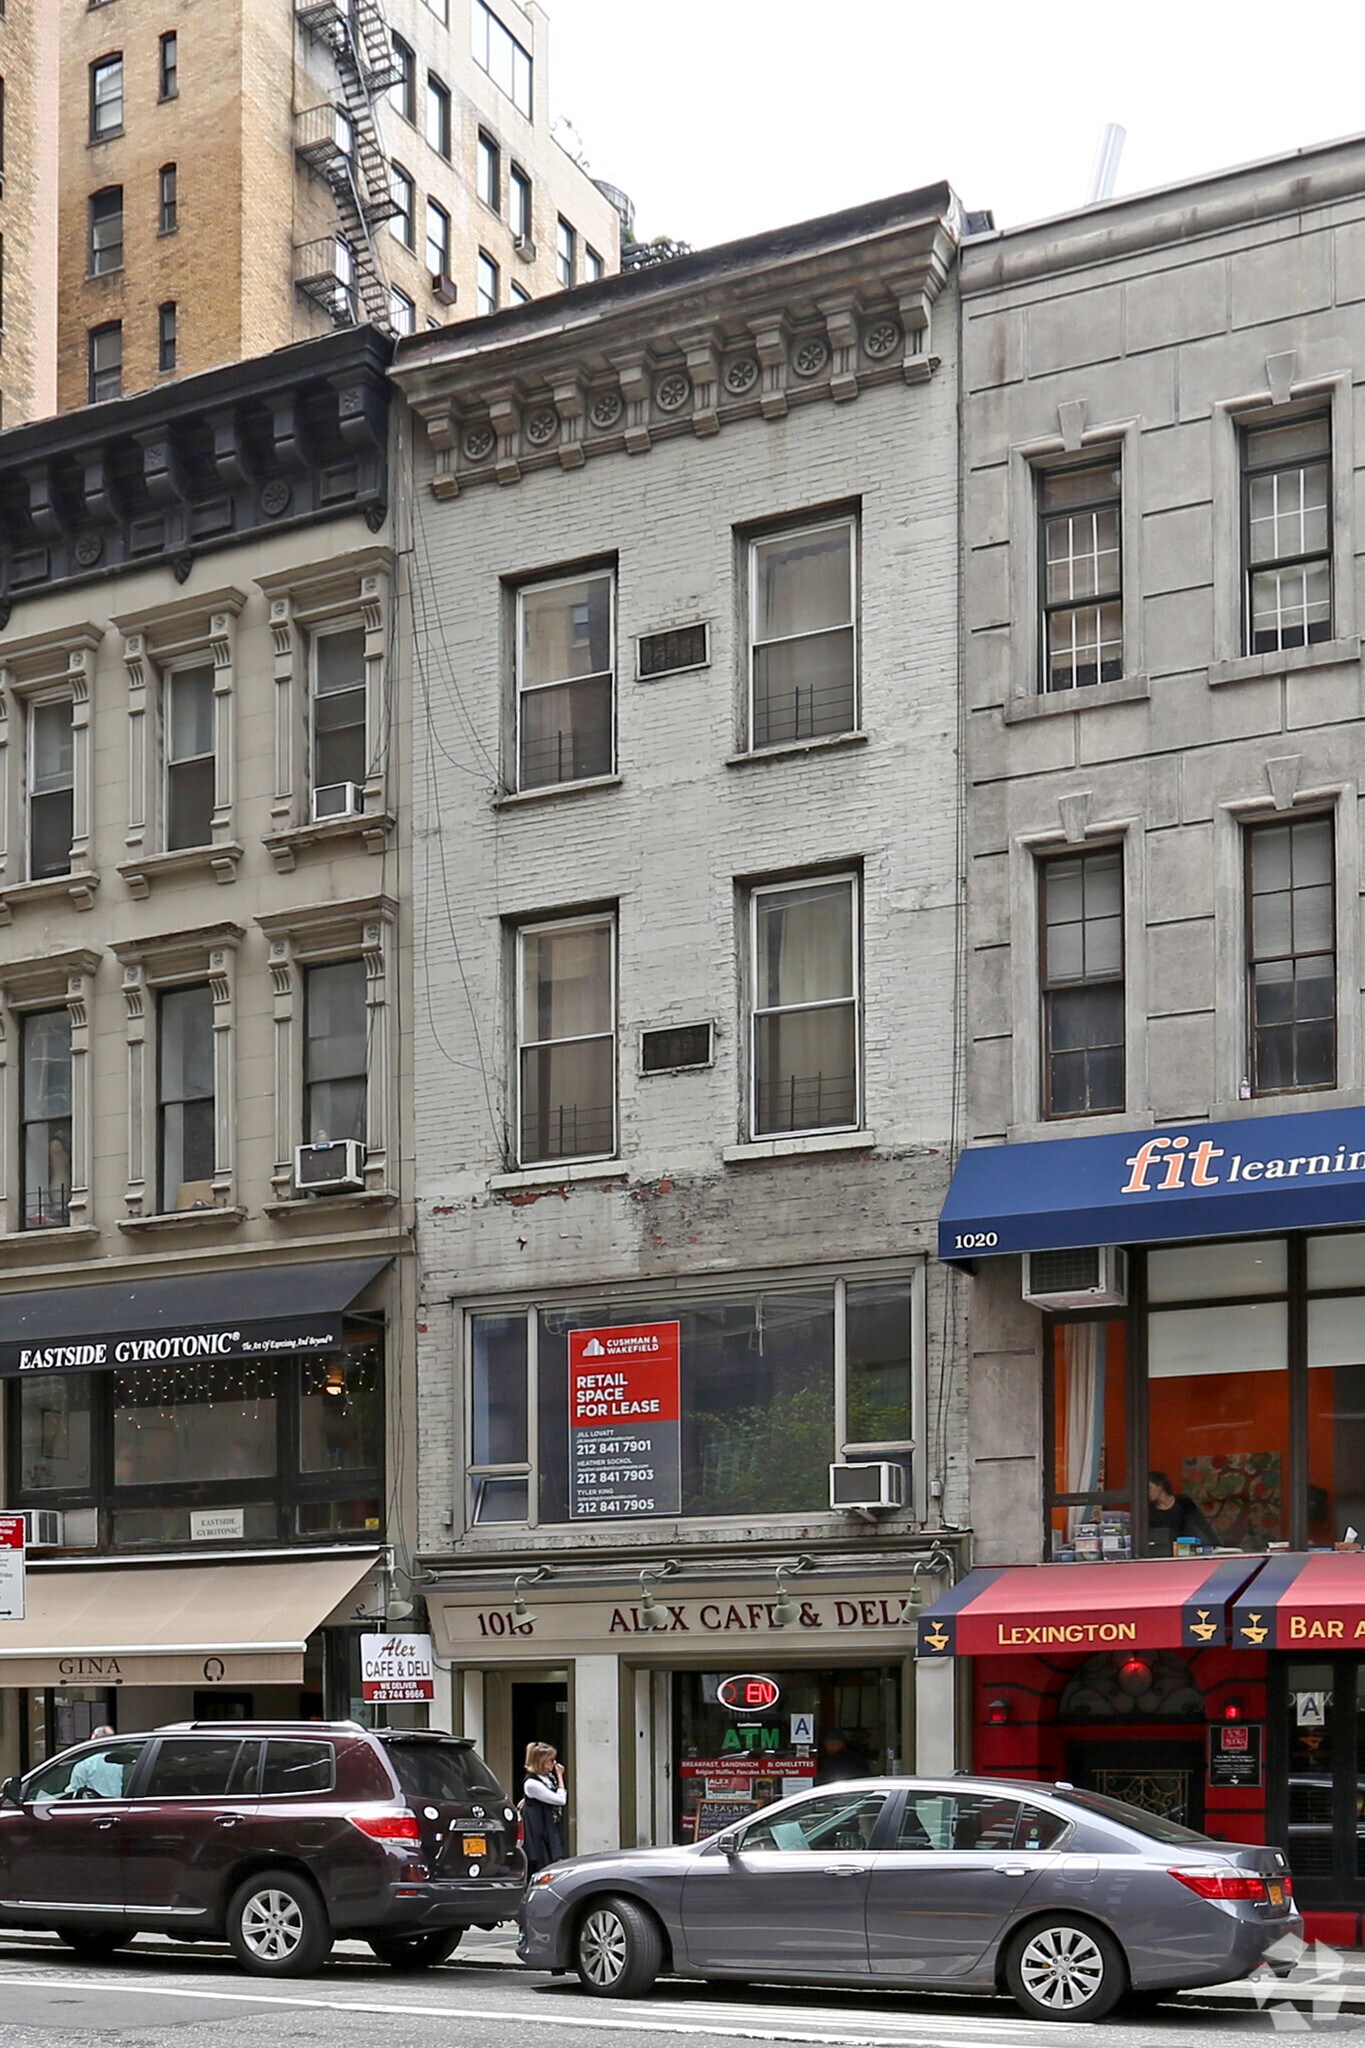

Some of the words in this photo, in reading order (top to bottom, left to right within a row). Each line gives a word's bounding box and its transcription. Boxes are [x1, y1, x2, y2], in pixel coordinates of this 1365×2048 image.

[1121, 1136, 1225, 1193] fit
[955, 1232, 998, 1249] 1020
[606, 1336, 651, 1347] CUSHMAN
[607, 1344, 659, 1355] WAKEFIELD
[19, 1344, 107, 1370] EASTSIDE
[577, 1373, 628, 1388] RETAIL
[577, 1387, 624, 1403] SPACE
[577, 1403, 608, 1418] FOR
[612, 1399, 660, 1415] LEASE
[577, 1444, 597, 1456] 212
[599, 1442, 619, 1454] 841
[623, 1439, 651, 1453] 7901
[577, 1459, 605, 1467] HEATHER
[577, 1473, 597, 1484] 212
[600, 1471, 620, 1483] 841
[623, 1469, 654, 1481] 7903
[577, 1502, 597, 1513] 212
[600, 1500, 620, 1512] 841
[623, 1498, 654, 1511] 7905
[201, 1518, 236, 1527] EASTSIDE
[609, 1604, 687, 1632] ALX
[800, 1602, 823, 1628] &
[998, 1623, 1136, 1645] LEXINGTON
[1290, 1617, 1344, 1639] BAR
[378, 1637, 416, 1658] Alex
[58, 1657, 122, 1674] GINA
[365, 1661, 394, 1677] CAFE
[397, 1661, 405, 1677] &
[407, 1660, 430, 1677] DELI
[391, 1681, 417, 1690] DELIVER
[722, 1683, 774, 1703] OEN
[373, 1690, 387, 1700] 212
[388, 1689, 404, 1699] 744
[1302, 1697, 1320, 1717] A
[794, 1718, 810, 1735] A
[721, 1728, 779, 1749] ATM
[774, 1760, 815, 1768] OMELETTES
